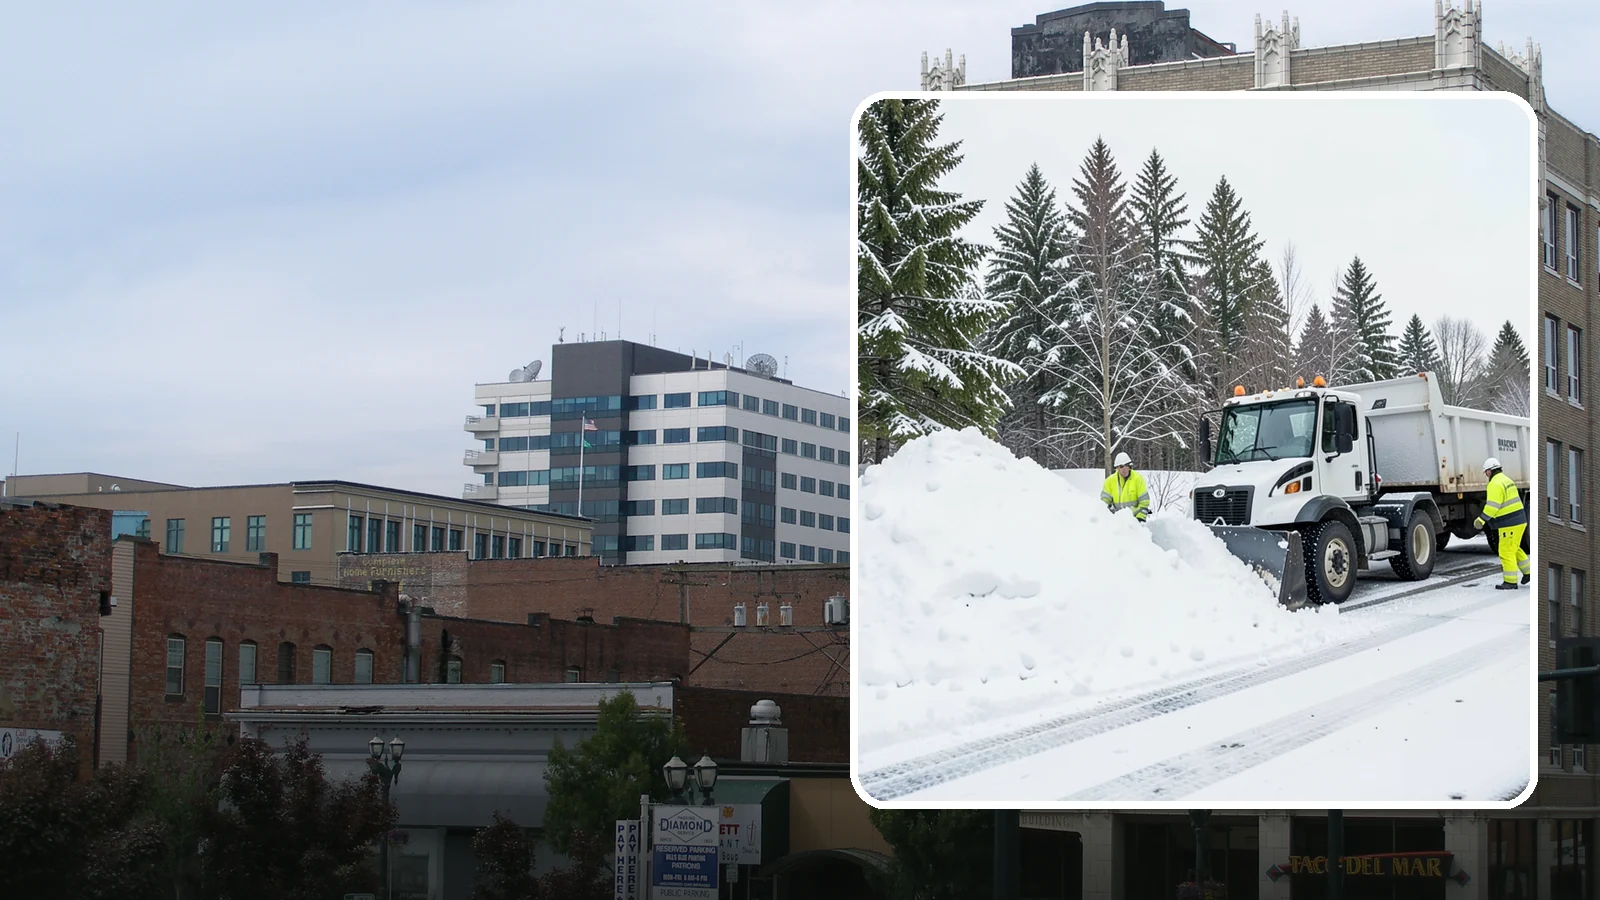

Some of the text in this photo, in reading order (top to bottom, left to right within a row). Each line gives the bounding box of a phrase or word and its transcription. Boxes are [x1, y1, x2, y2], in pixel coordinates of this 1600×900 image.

[343, 566, 427, 577] Home Furnishers
[660, 818, 713, 833] DIAMOND
[1022, 815, 1070, 827] BUILDING
[655, 845, 716, 854] RESERVED PARKING
[617, 825, 625, 893] PAY HERE
[628, 825, 636, 893] PAY HERE
[722, 851, 739, 861] Soup
[671, 862, 701, 870] PATRONS
[1346, 856, 1385, 875] DEL
[1392, 857, 1442, 877] MAR
[660, 889, 710, 898] PUBLIC PARKING
